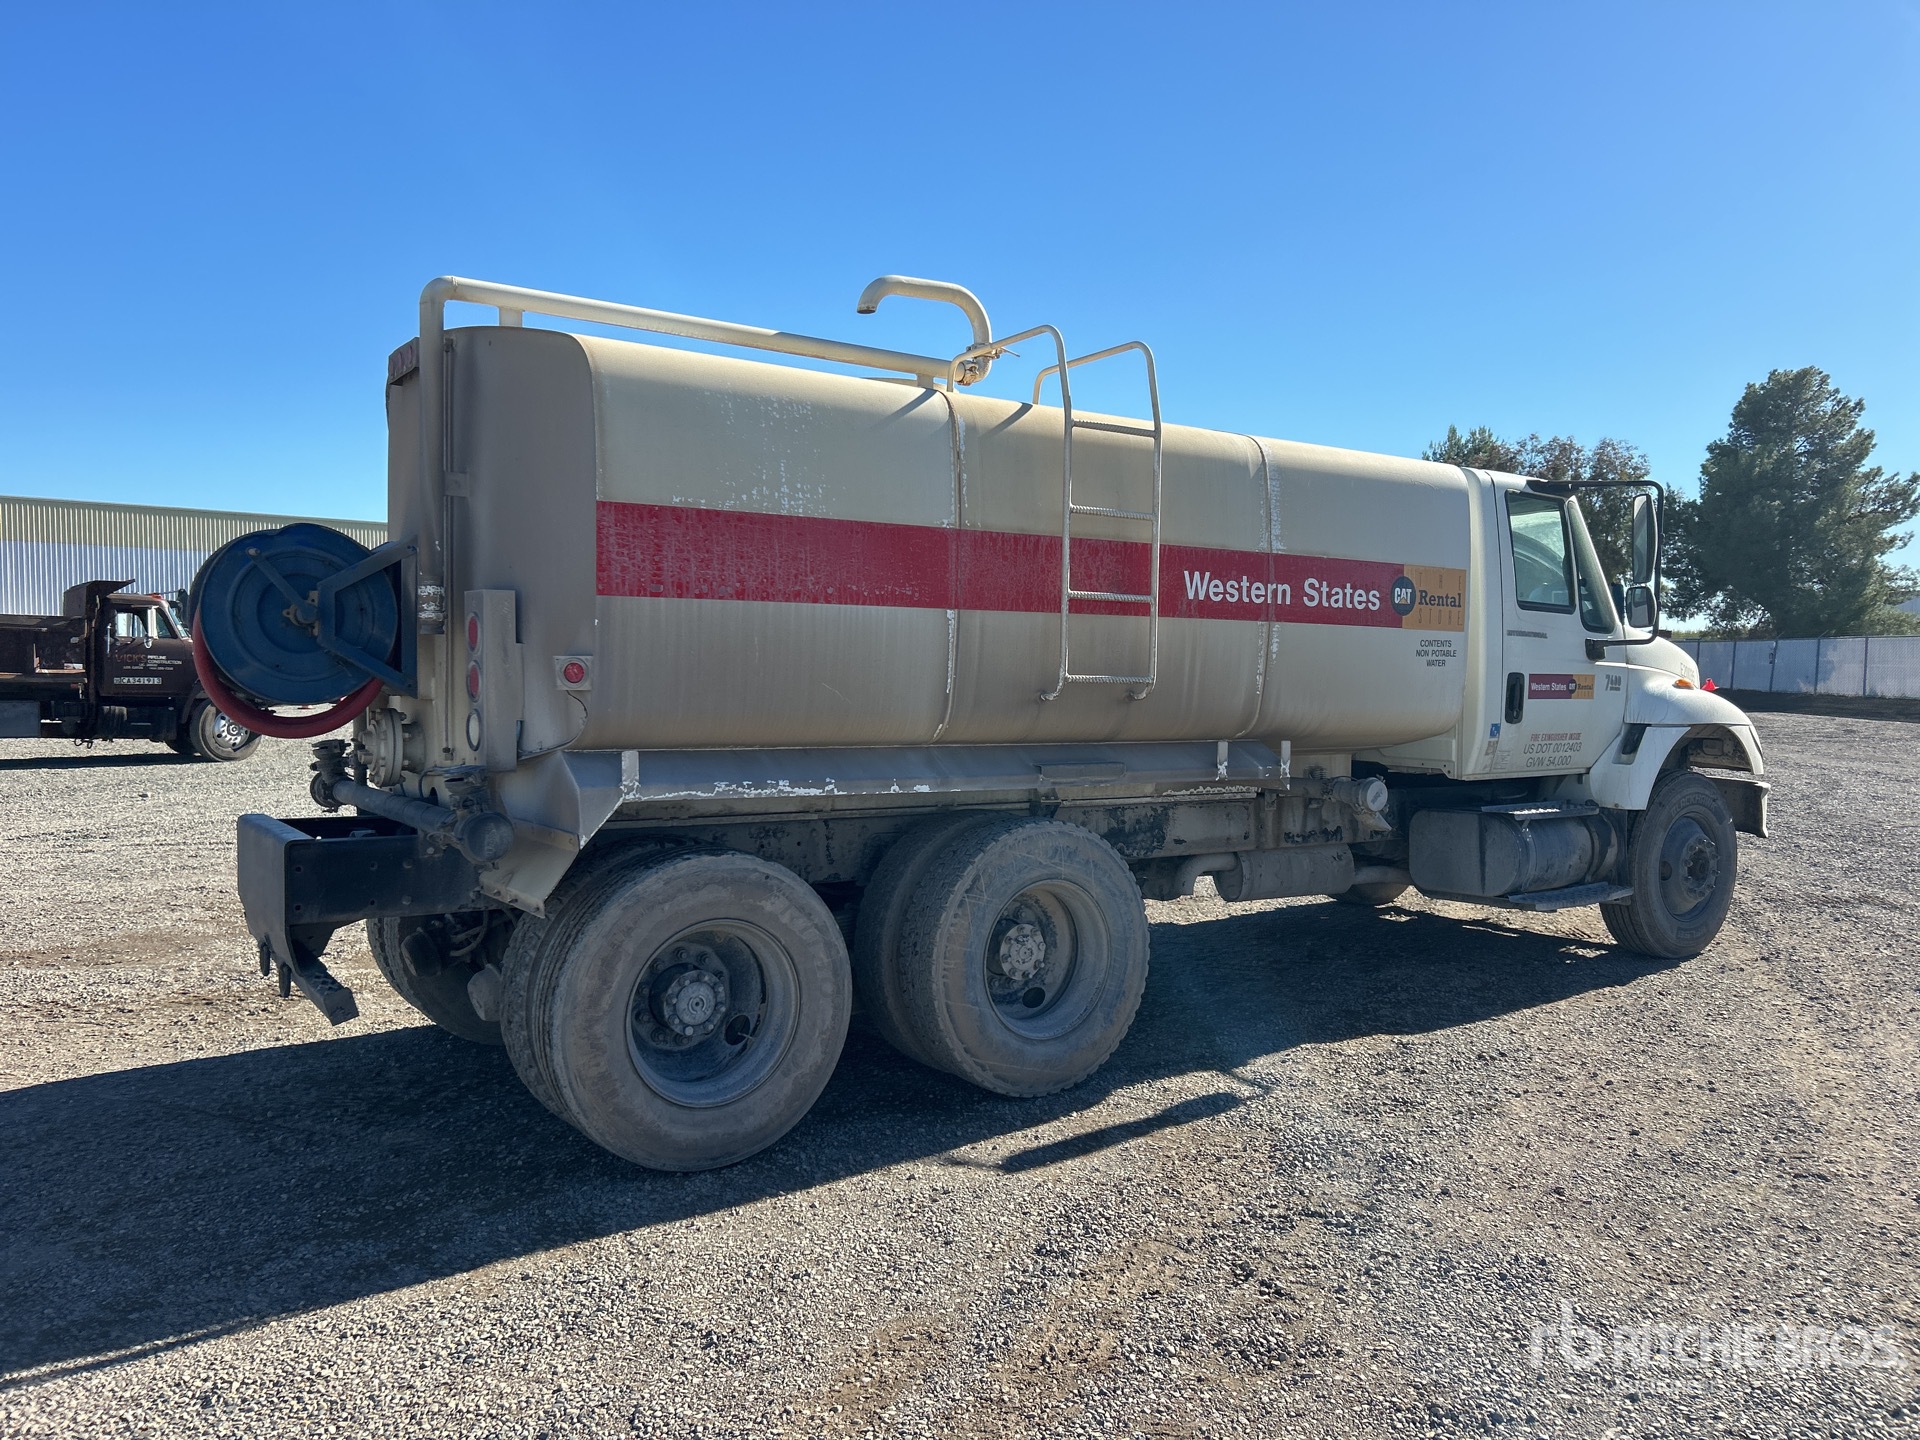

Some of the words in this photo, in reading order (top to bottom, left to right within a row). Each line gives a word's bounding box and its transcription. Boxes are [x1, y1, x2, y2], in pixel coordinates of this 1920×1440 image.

[1418, 572, 1462, 591] THE
[1184, 570, 1291, 605] Western
[1303, 577, 1381, 611] States
[1394, 587, 1412, 605] CAT
[1419, 589, 1462, 608] Rental
[1420, 639, 1452, 648] CONTENTS
[1415, 649, 1429, 657] NON
[1431, 649, 1457, 658] POTABLE
[1426, 659, 1446, 667] WATER
[1530, 682, 1550, 691] Western
[1551, 682, 1567, 691] States
[1523, 743, 1535, 755] US
[1535, 743, 1553, 754] DOT
[1552, 741, 1583, 753] 0012403
[1526, 756, 1546, 768] GVW
[1546, 755, 1572, 767] 54,000
